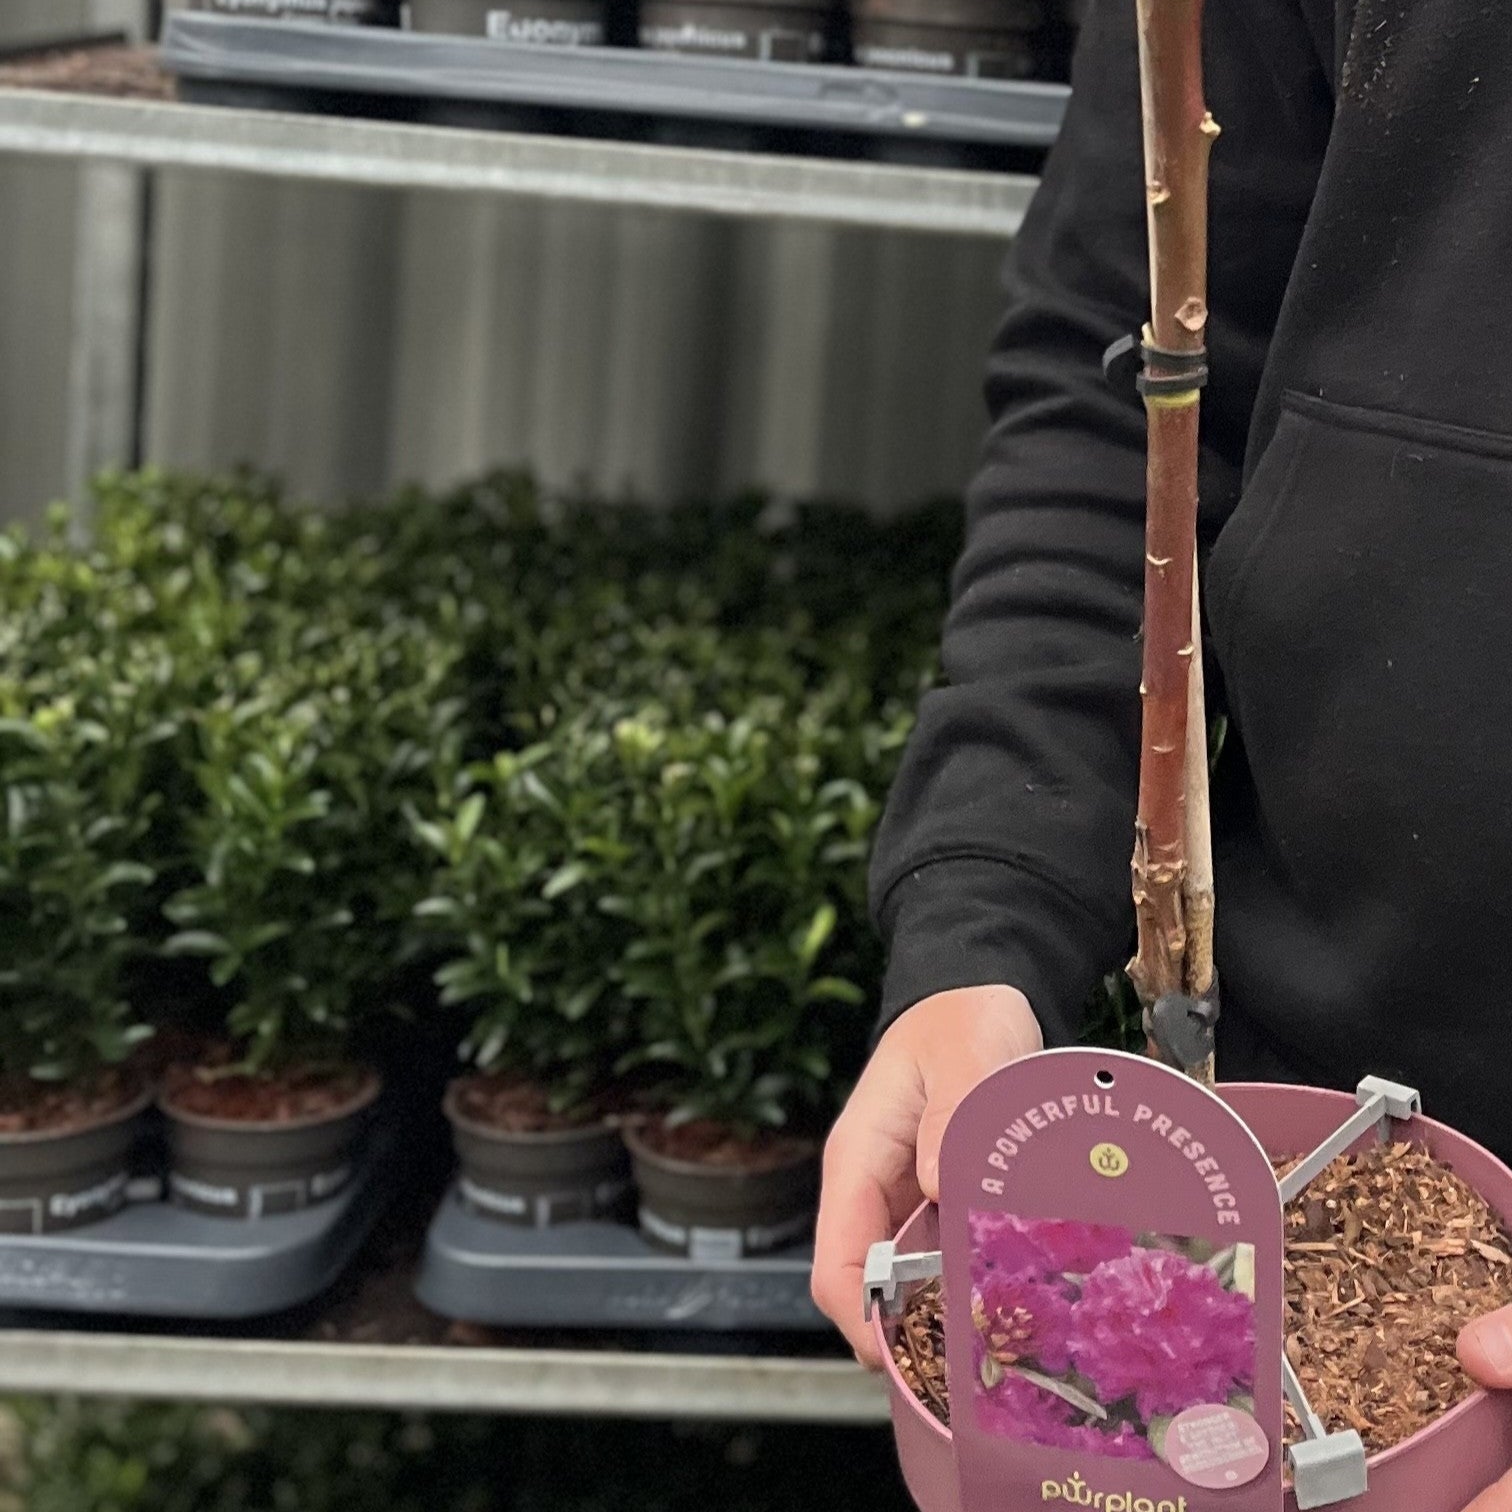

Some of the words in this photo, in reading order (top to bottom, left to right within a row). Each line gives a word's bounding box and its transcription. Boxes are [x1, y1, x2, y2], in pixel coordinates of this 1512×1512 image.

[987, 1093, 1120, 1171] POWERFUL
[1132, 1103, 1241, 1226] PRESENCE
[981, 1177, 1005, 1195] A
